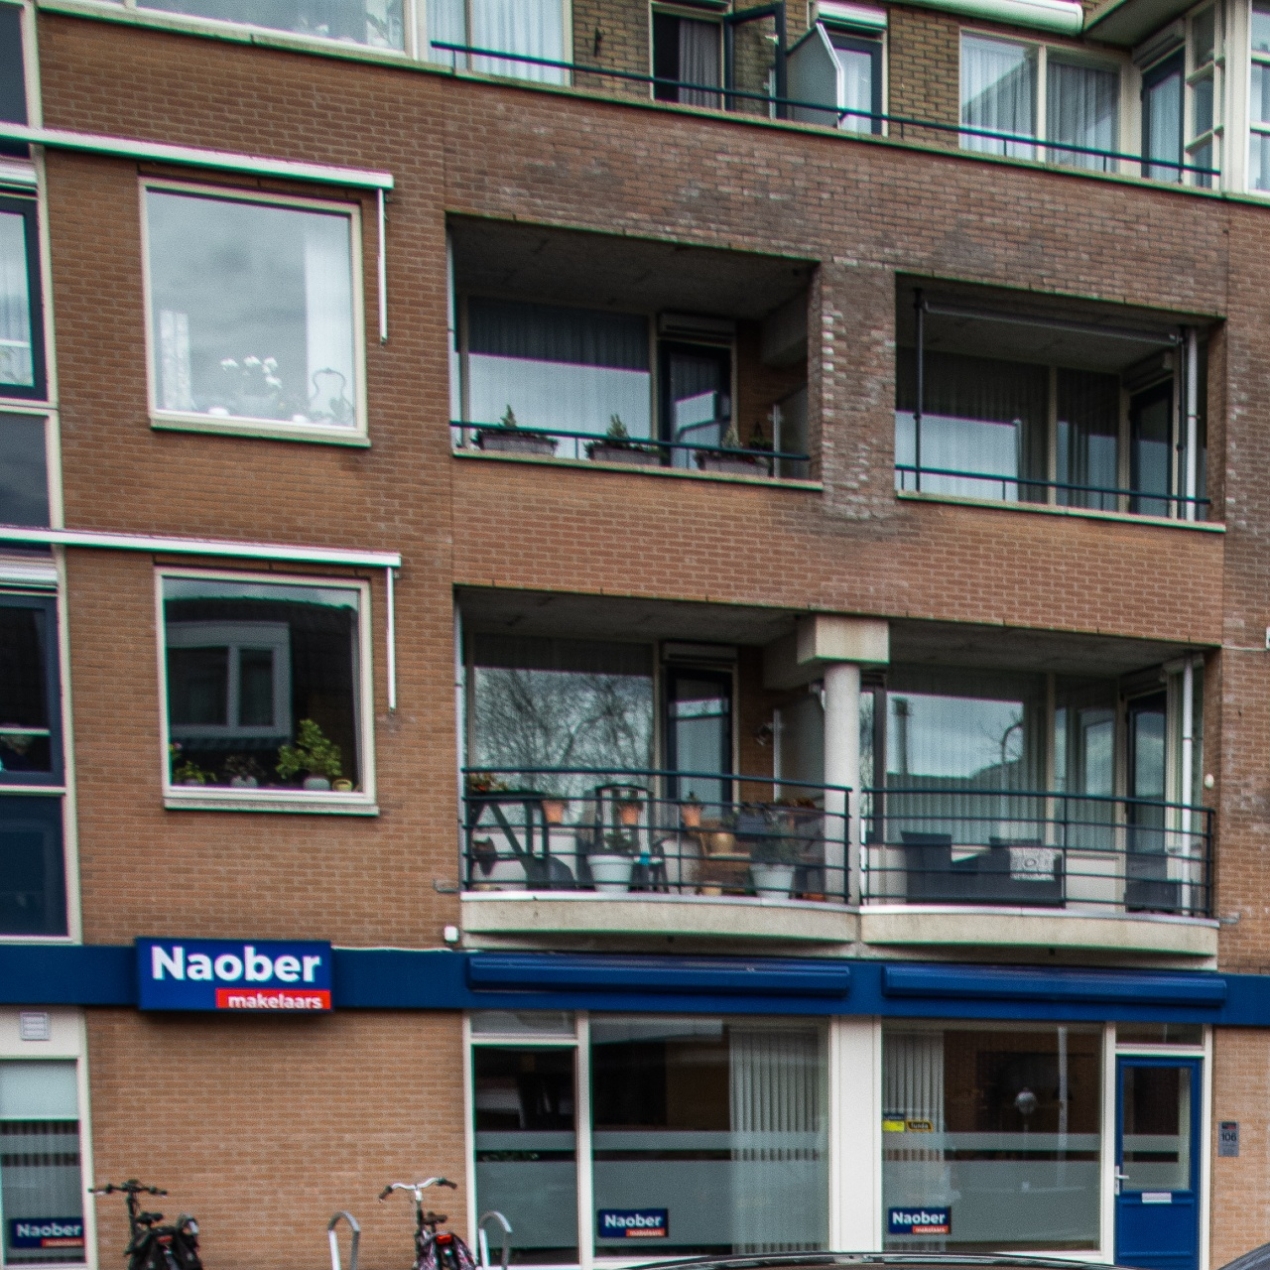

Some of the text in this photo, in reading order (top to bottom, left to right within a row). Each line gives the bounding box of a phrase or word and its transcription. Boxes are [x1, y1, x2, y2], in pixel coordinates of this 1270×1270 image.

[152, 945, 322, 983] Naober
[227, 992, 323, 1009] makelaars
[604, 1213, 662, 1228] Naober
[892, 1211, 945, 1225] Naober
[16, 1222, 82, 1238] Naober
